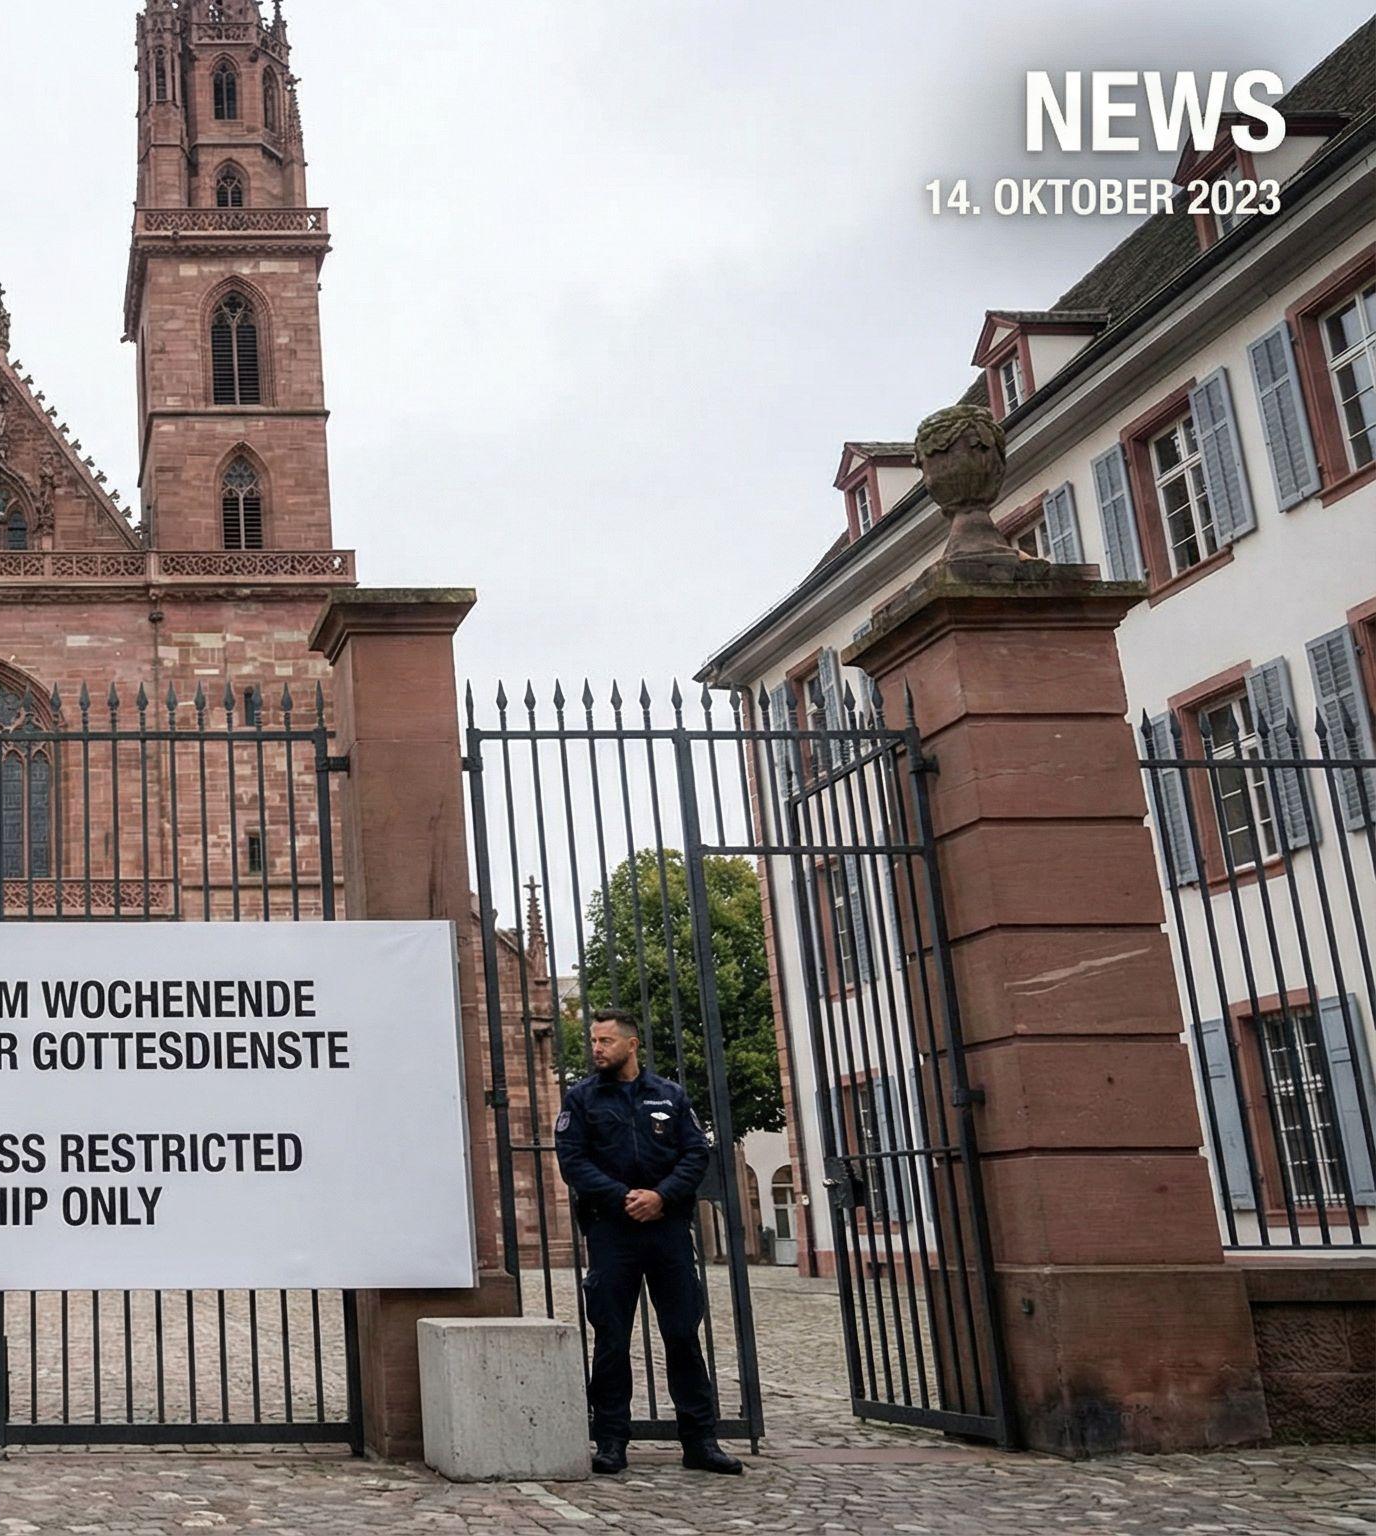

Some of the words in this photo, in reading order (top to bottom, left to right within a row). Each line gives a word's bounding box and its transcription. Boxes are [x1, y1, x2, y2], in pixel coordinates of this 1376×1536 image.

[42, 980, 316, 1018] WOCHENENDE
[33, 1031, 349, 1070] GOTTESDIENSTE
[61, 1133, 302, 1173] RESTRICTED
[63, 1186, 162, 1226] ONLY
